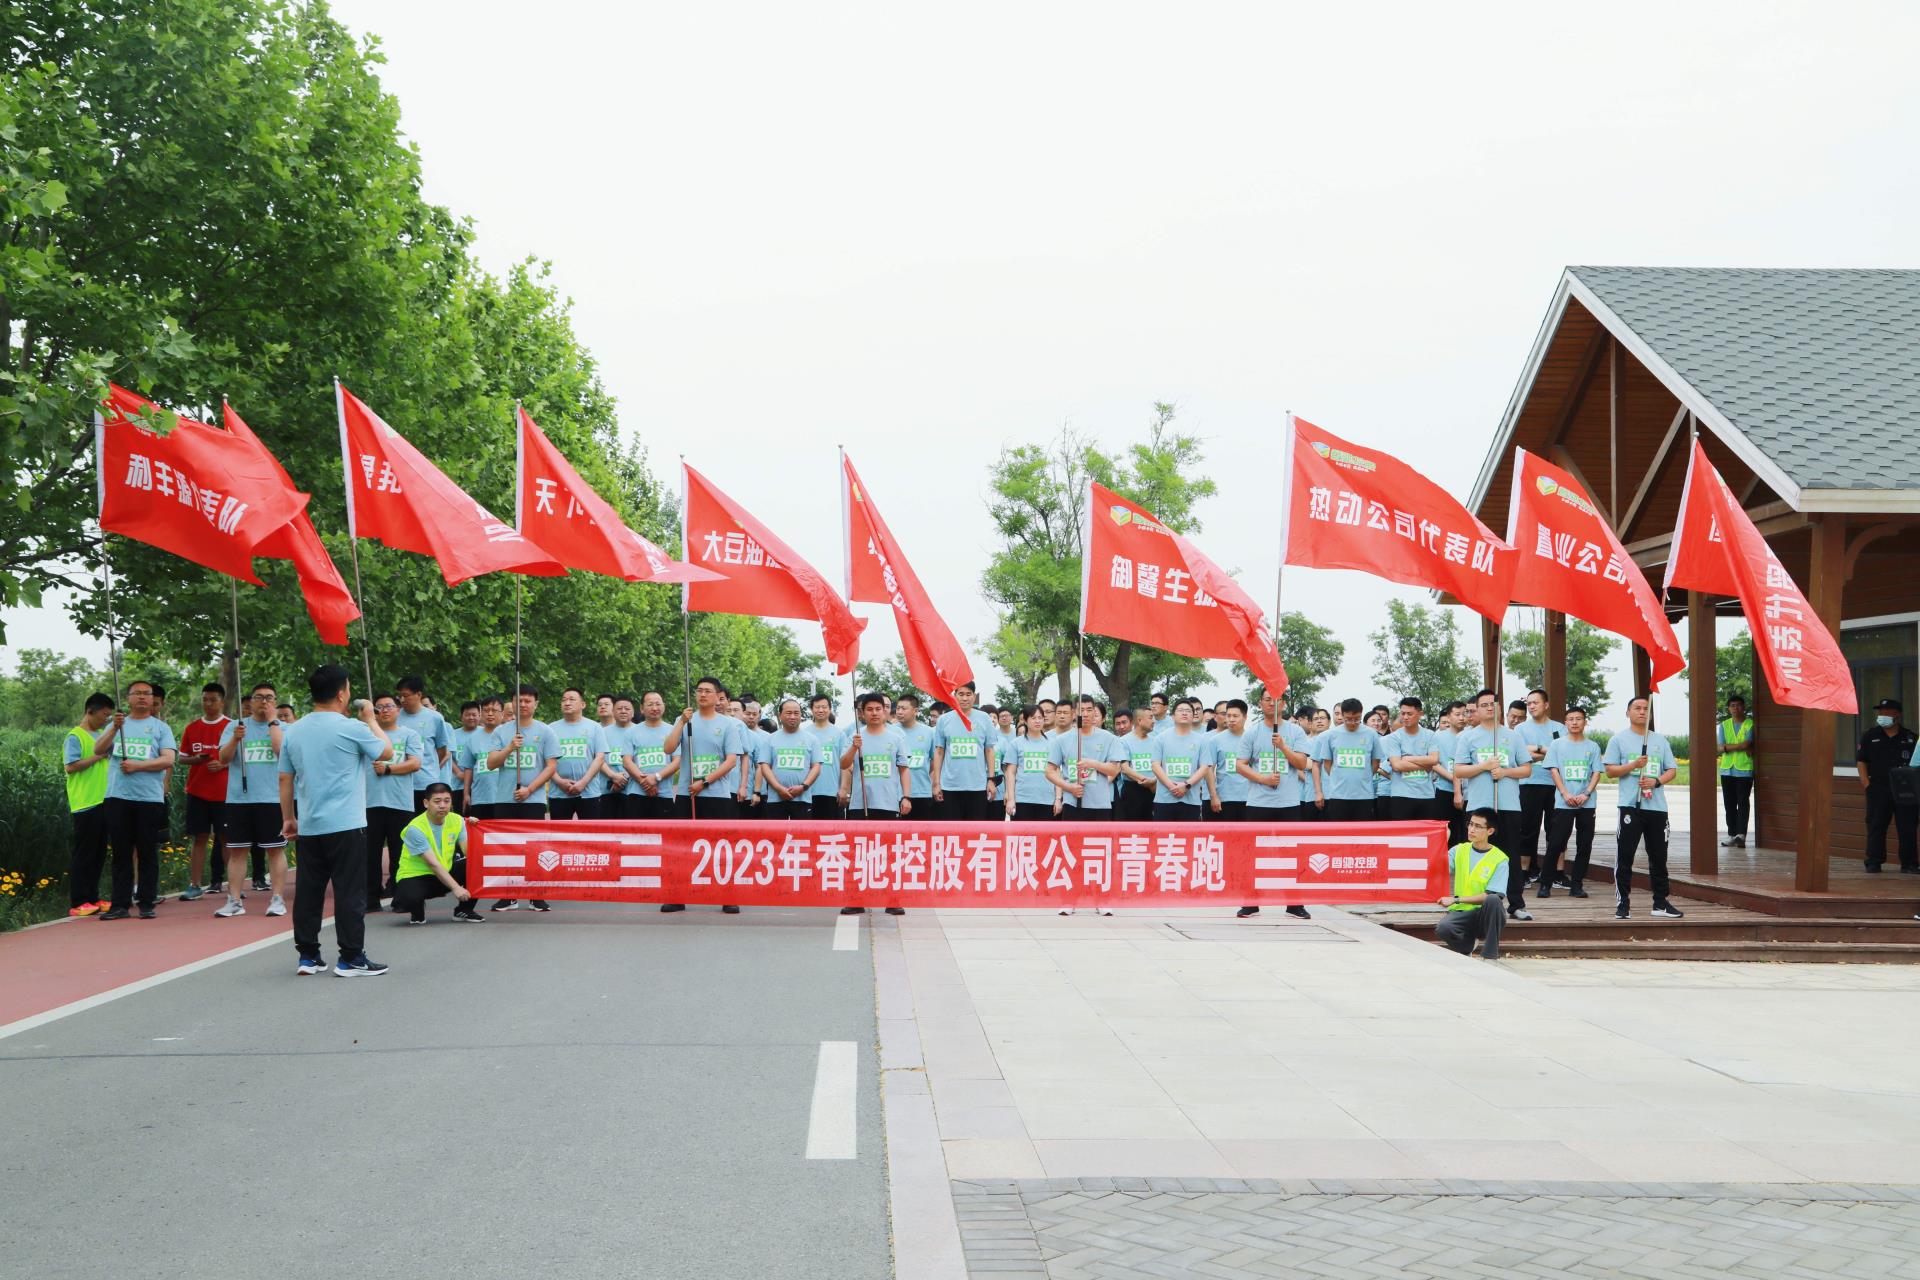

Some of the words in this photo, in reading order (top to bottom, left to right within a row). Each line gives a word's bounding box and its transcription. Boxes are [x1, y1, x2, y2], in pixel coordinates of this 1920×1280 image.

[1309, 486, 1495, 576] 热动公司代表队
[248, 749, 274, 760] 778
[952, 745, 974, 755] 301
[640, 753, 664, 765] 300
[780, 756, 803, 767] 077
[1339, 756, 1363, 766] 310
[864, 763, 889, 774] 053
[1168, 764, 1190, 774] 858
[691, 833, 1226, 892] 2023年香驰控股有限公司青春跑
